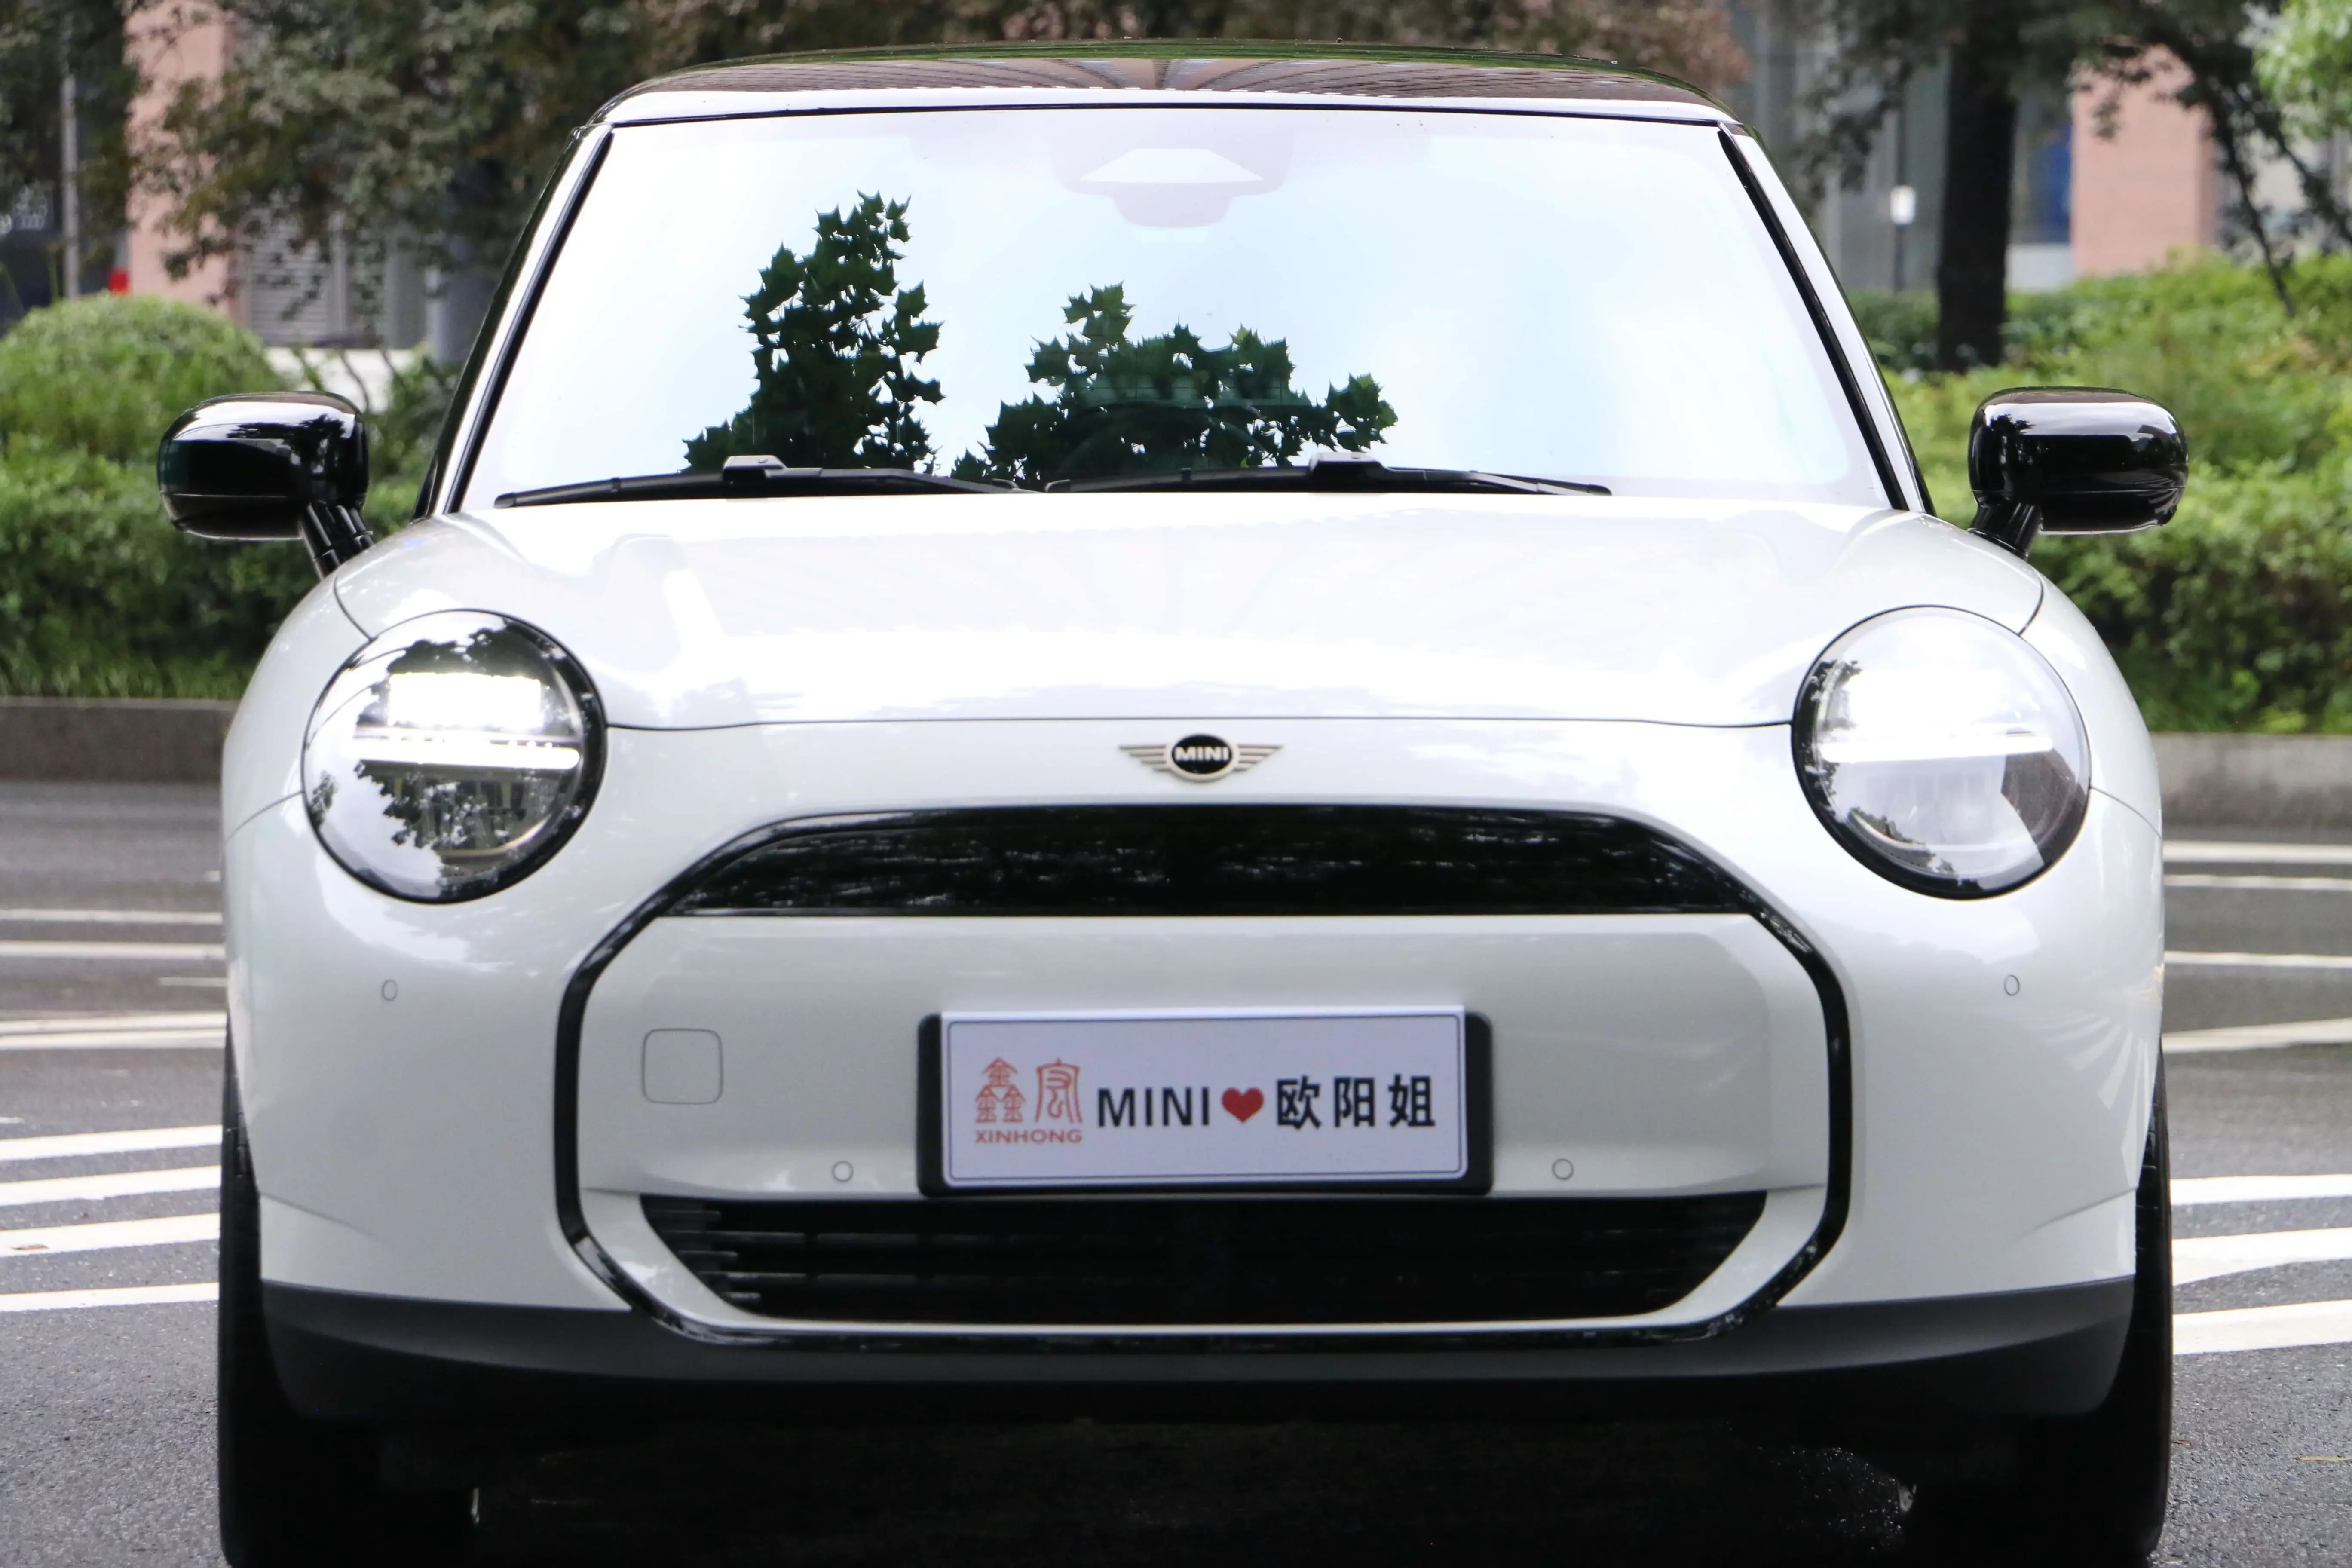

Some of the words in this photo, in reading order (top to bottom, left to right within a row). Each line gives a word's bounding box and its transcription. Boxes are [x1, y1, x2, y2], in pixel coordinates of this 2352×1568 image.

[1174, 746, 1229, 762] MINI
[1097, 1087, 1210, 1128] MINI
[1276, 1073, 1436, 1130] 欧阳姐
[975, 1129, 1083, 1144] XINHONG
